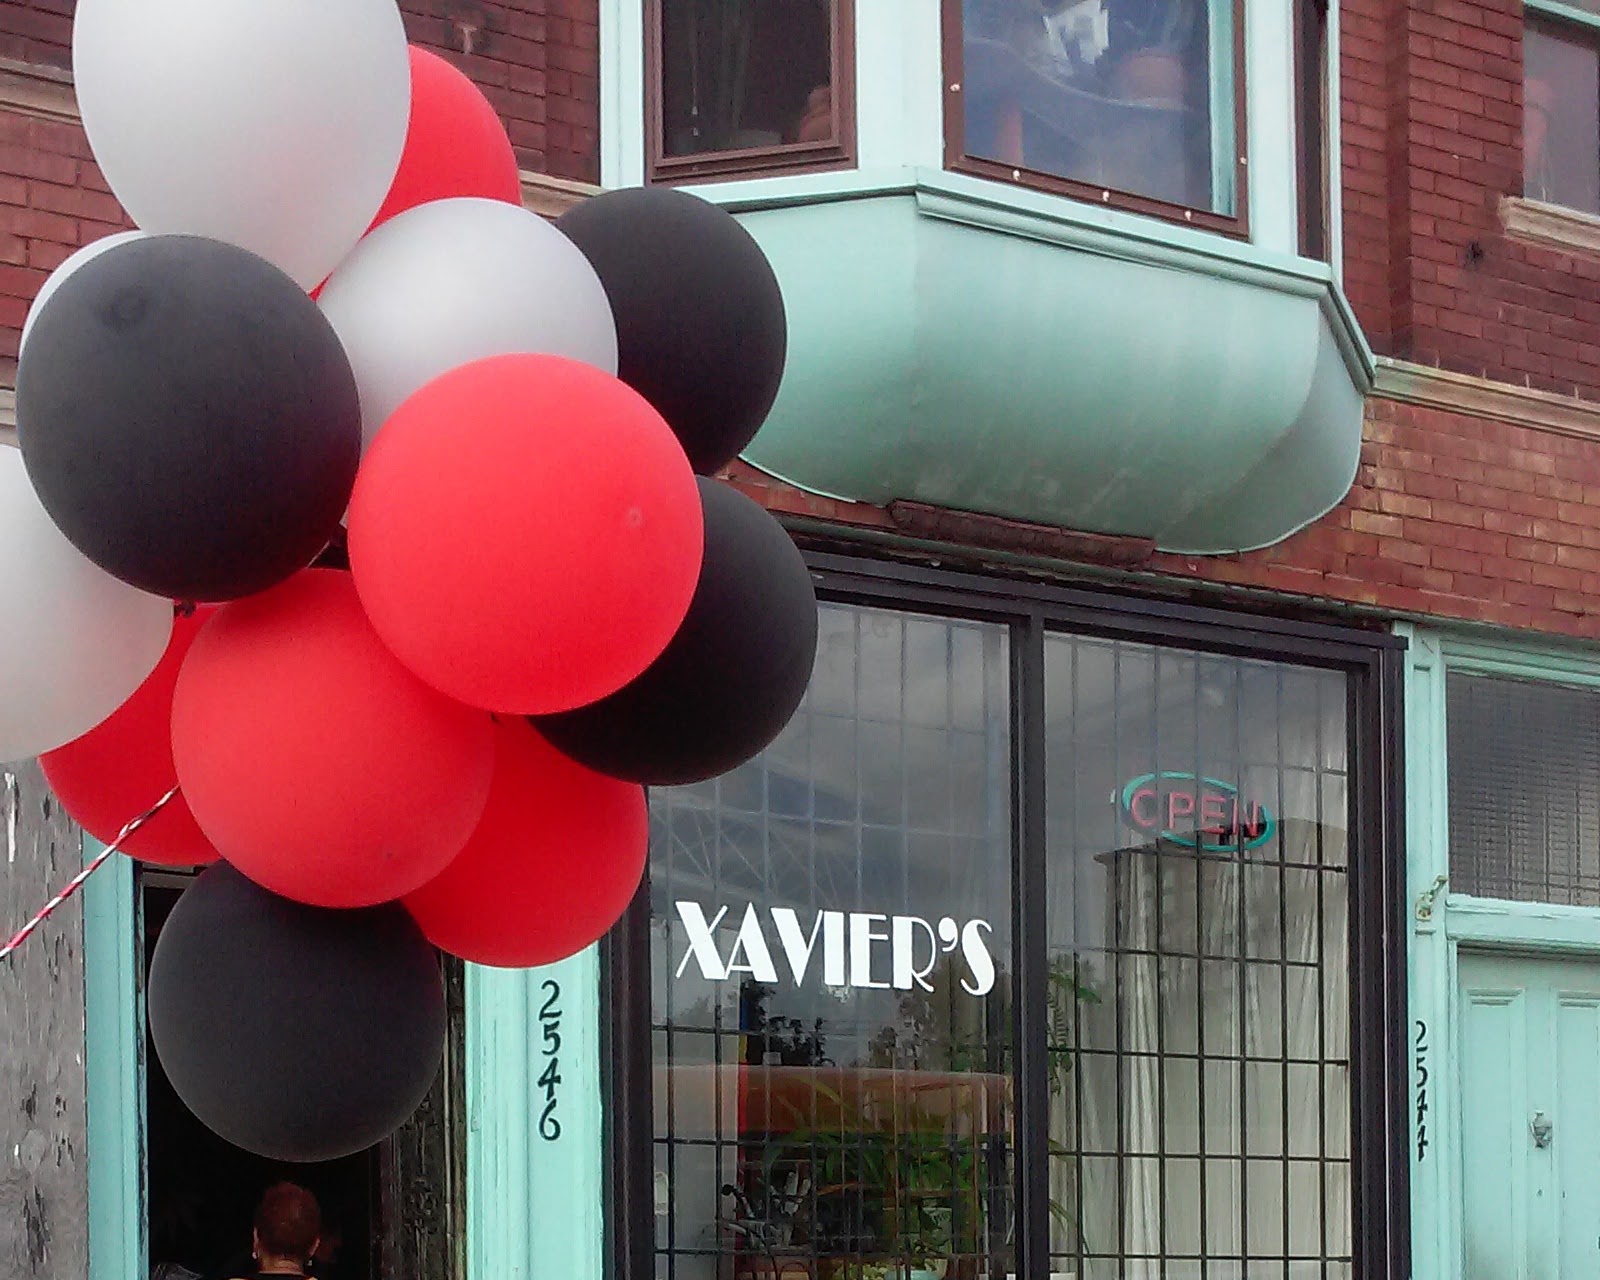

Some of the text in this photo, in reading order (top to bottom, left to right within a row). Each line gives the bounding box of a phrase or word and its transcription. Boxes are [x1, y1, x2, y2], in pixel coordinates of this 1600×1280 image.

[675, 901, 996, 996] XAVIER'S
[537, 979, 563, 1141] 2546
[1415, 1020, 1429, 1163] 2544
